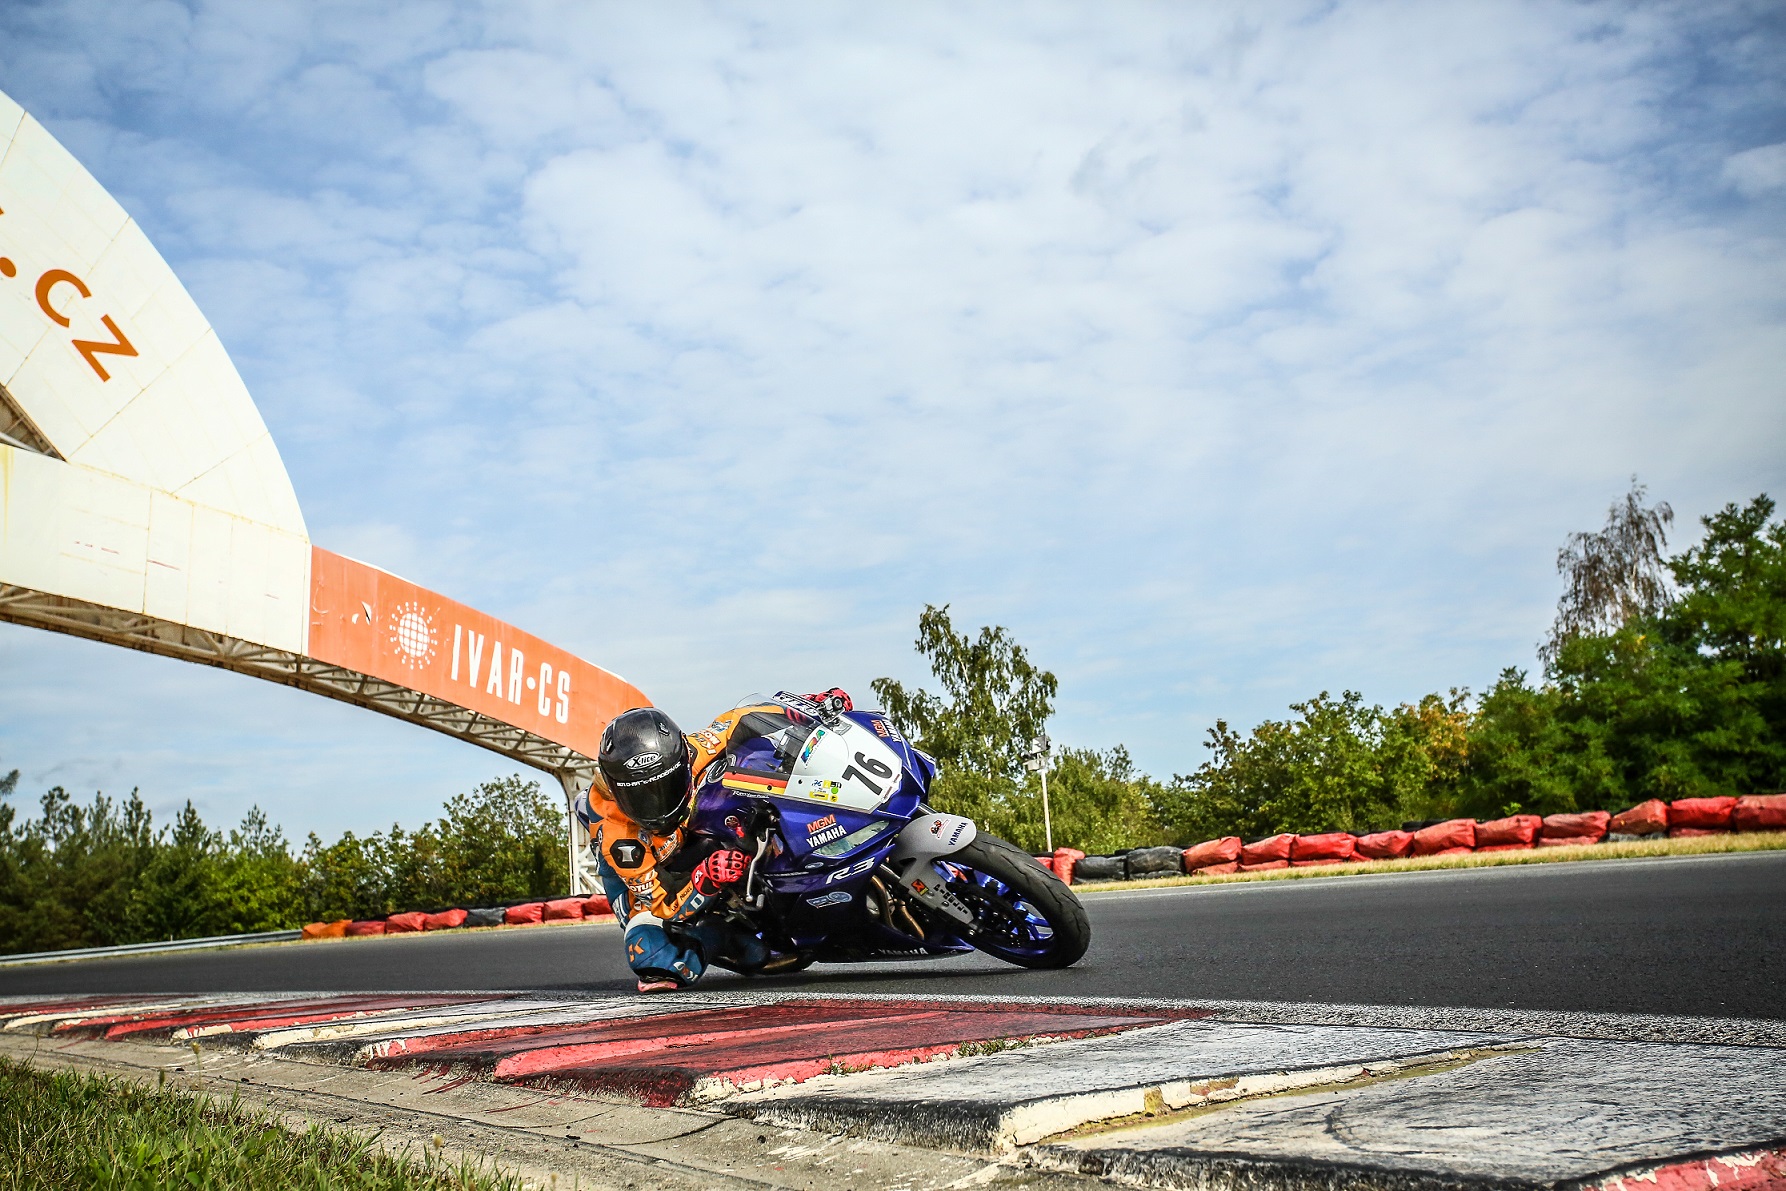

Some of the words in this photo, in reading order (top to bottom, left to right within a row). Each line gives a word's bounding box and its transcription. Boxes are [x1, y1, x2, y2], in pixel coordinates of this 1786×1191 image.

[0, 208, 139, 382] .CZ
[842, 751, 893, 796] 76
[806, 814, 836, 833] MGM
[949, 822, 968, 846] YAMAHA
[806, 825, 847, 848] YAMAHA
[825, 857, 875, 885] R3
[629, 880, 654, 893] OTUL
